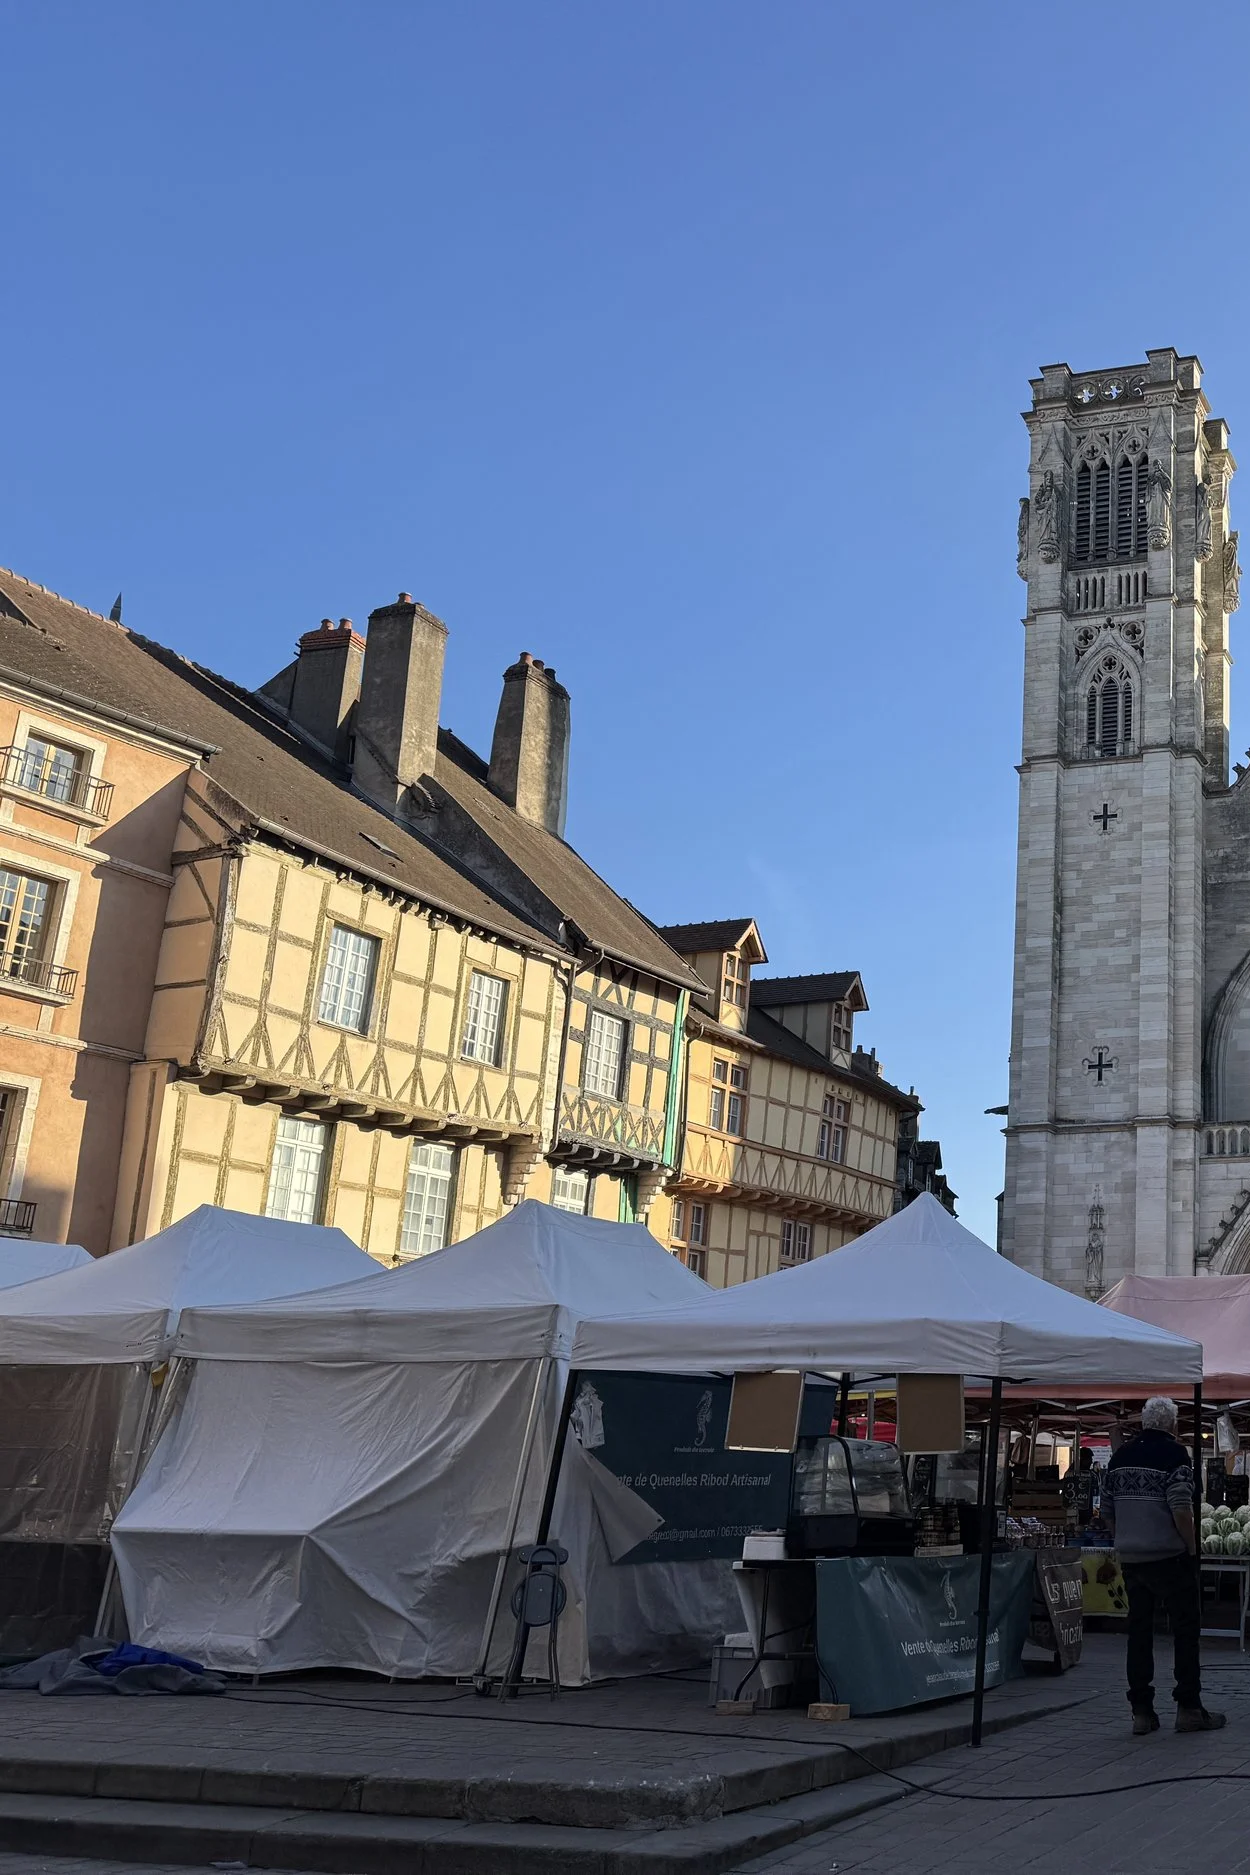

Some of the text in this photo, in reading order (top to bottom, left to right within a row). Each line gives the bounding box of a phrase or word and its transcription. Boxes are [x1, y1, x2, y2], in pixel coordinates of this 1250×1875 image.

[635, 1473, 647, 1487] de
[649, 1473, 698, 1490] Quenelles
[700, 1473, 729, 1487] Ribod
[731, 1473, 772, 1487] Artisanal
[901, 1640, 925, 1657] Vente
